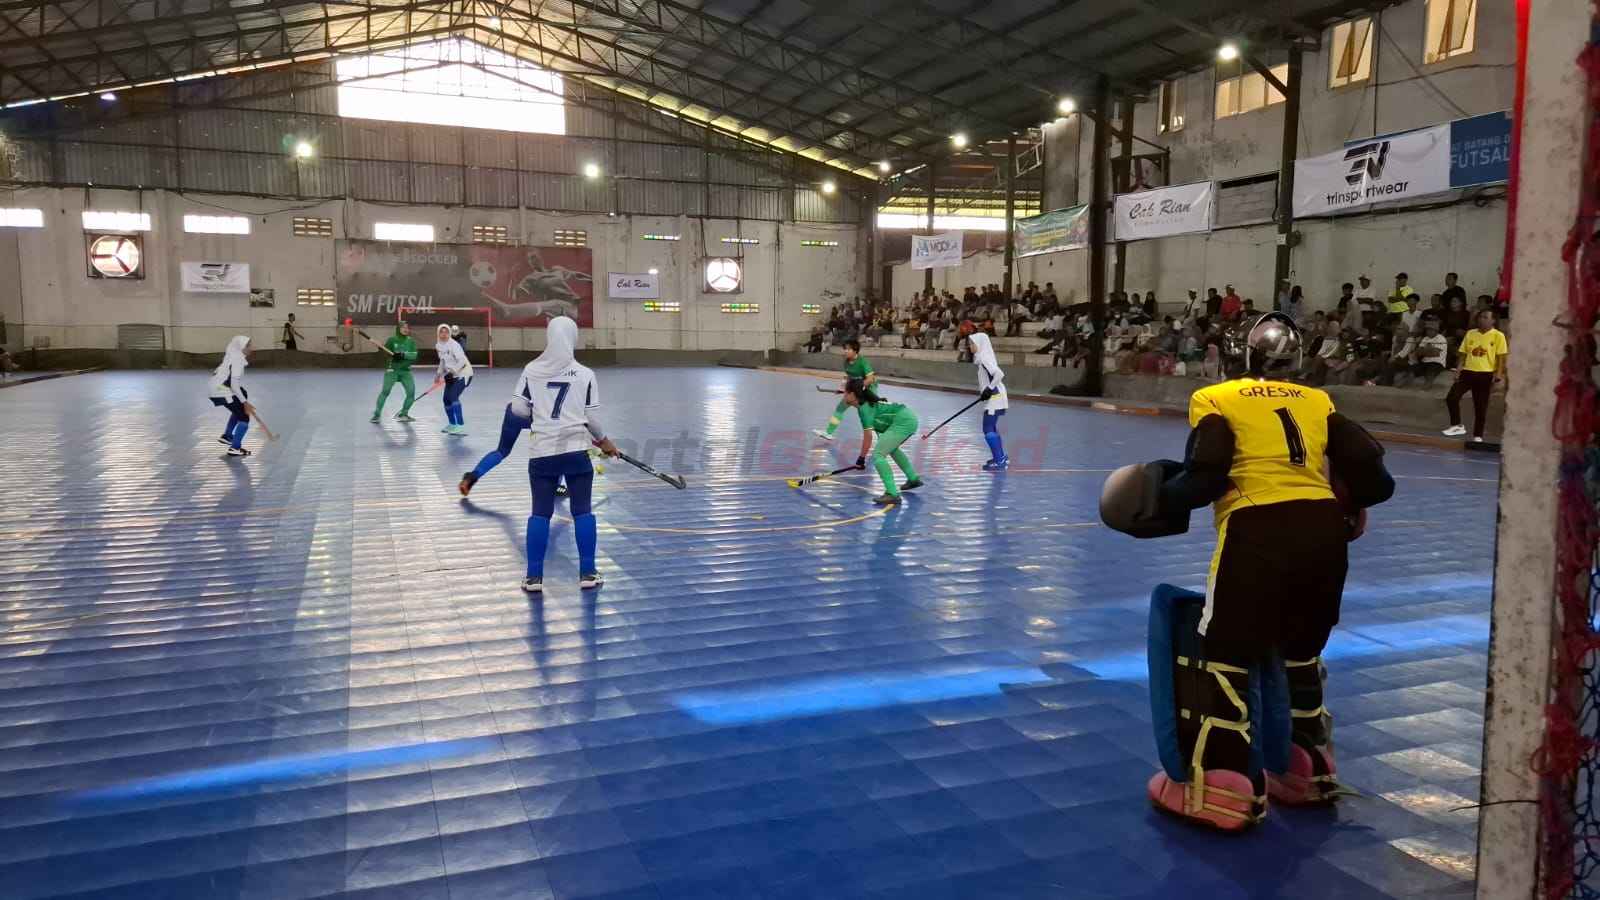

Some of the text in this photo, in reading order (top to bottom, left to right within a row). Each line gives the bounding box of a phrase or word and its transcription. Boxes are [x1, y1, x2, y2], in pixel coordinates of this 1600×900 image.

[1450, 146, 1512, 169] FUTSAL
[1326, 181, 1409, 205] trinsprtwear
[1129, 199, 1192, 219] Cak Rian
[347, 294, 434, 314] SM FUTSAL
[546, 381, 571, 419] 7
[1239, 386, 1305, 399] GRESIK
[1273, 406, 1307, 467] 1
